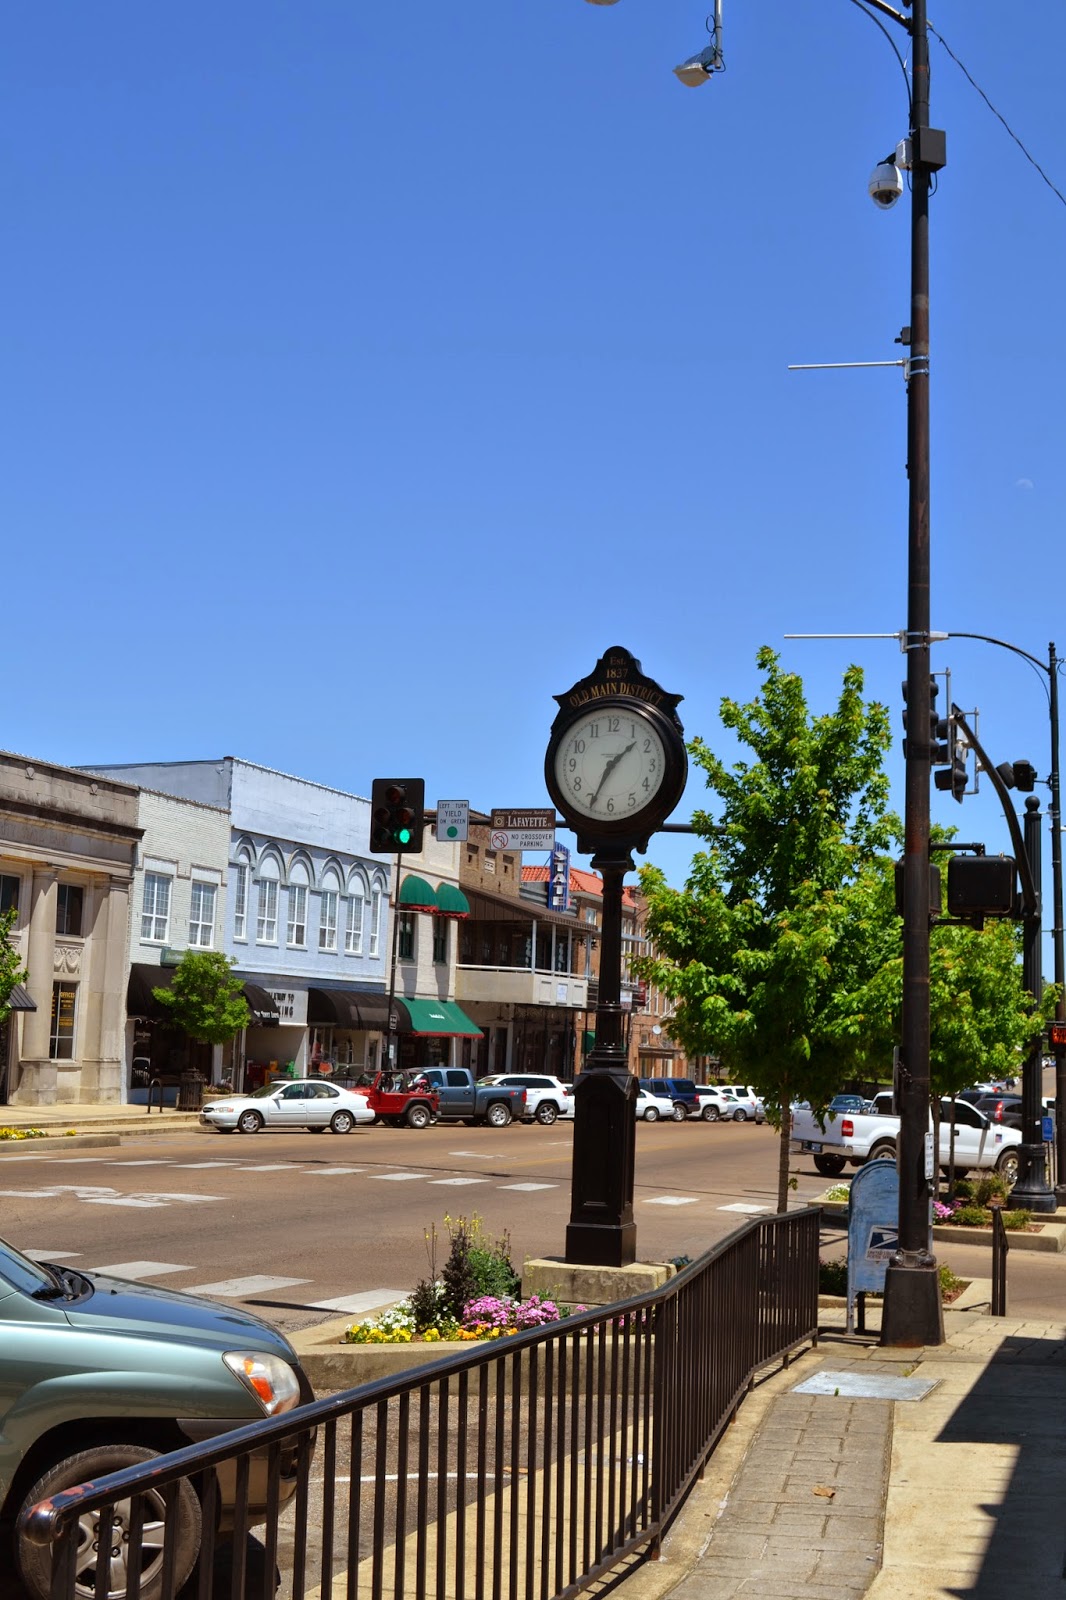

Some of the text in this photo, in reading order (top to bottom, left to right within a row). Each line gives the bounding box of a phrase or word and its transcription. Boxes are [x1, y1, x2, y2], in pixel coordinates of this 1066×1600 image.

[606, 668, 629, 679] 1837
[569, 682, 664, 707] OLD MAIN DISTRICT
[590, 724, 599, 738] 11
[608, 718, 620, 732] 12
[573, 739, 586, 754] 10
[643, 739, 651, 753] 2
[569, 758, 577, 772] 9
[649, 759, 656, 773] 3
[573, 777, 582, 791] 8
[641, 777, 650, 792] 4
[607, 798, 615, 812] 6
[627, 792, 636, 807] 5
[507, 815, 548, 827] LAFAYETTE
[552, 851, 567, 906] STATE
